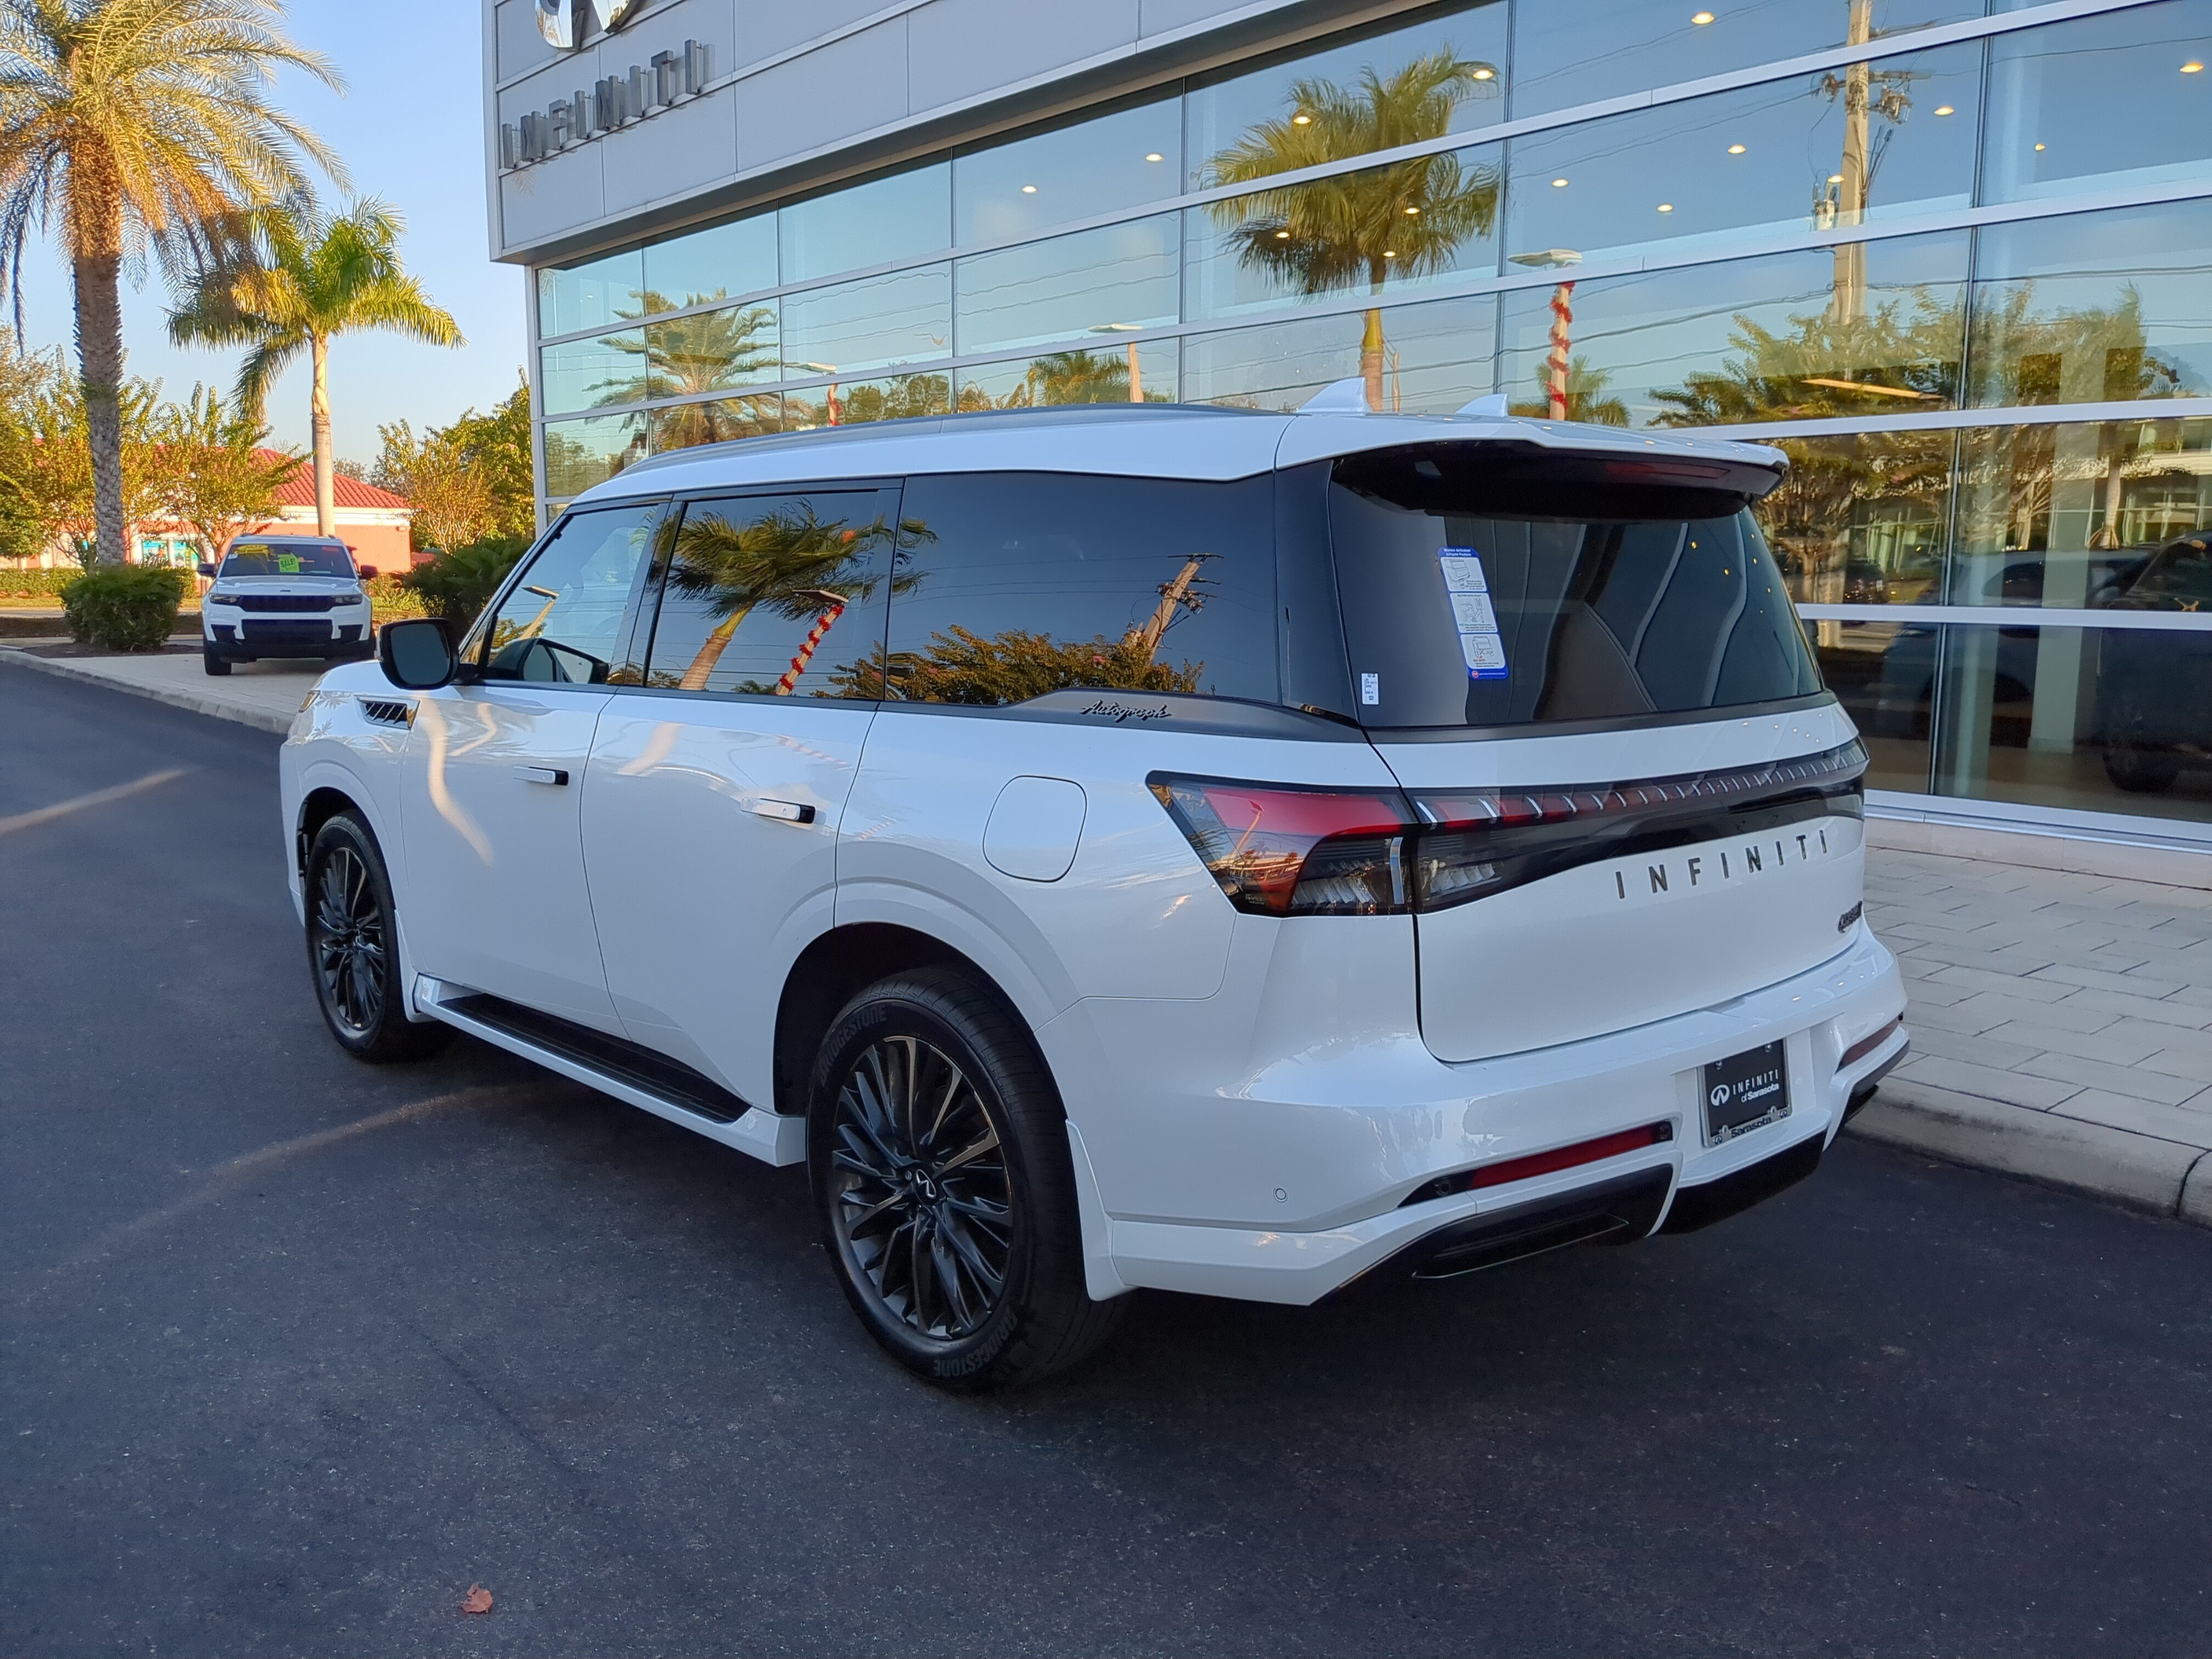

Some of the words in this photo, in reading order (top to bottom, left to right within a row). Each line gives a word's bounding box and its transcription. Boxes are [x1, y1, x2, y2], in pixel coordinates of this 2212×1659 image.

[502, 39, 699, 168] INFINITI
[280, 558, 296, 567] SALE!
[1080, 699, 1172, 723] Autograph
[1615, 829, 1827, 899] INFINITI
[1733, 1069, 1779, 1095] INFINITI
[1748, 1083, 1780, 1101] Sarasota
[1731, 1116, 1772, 1138] Sarasota
